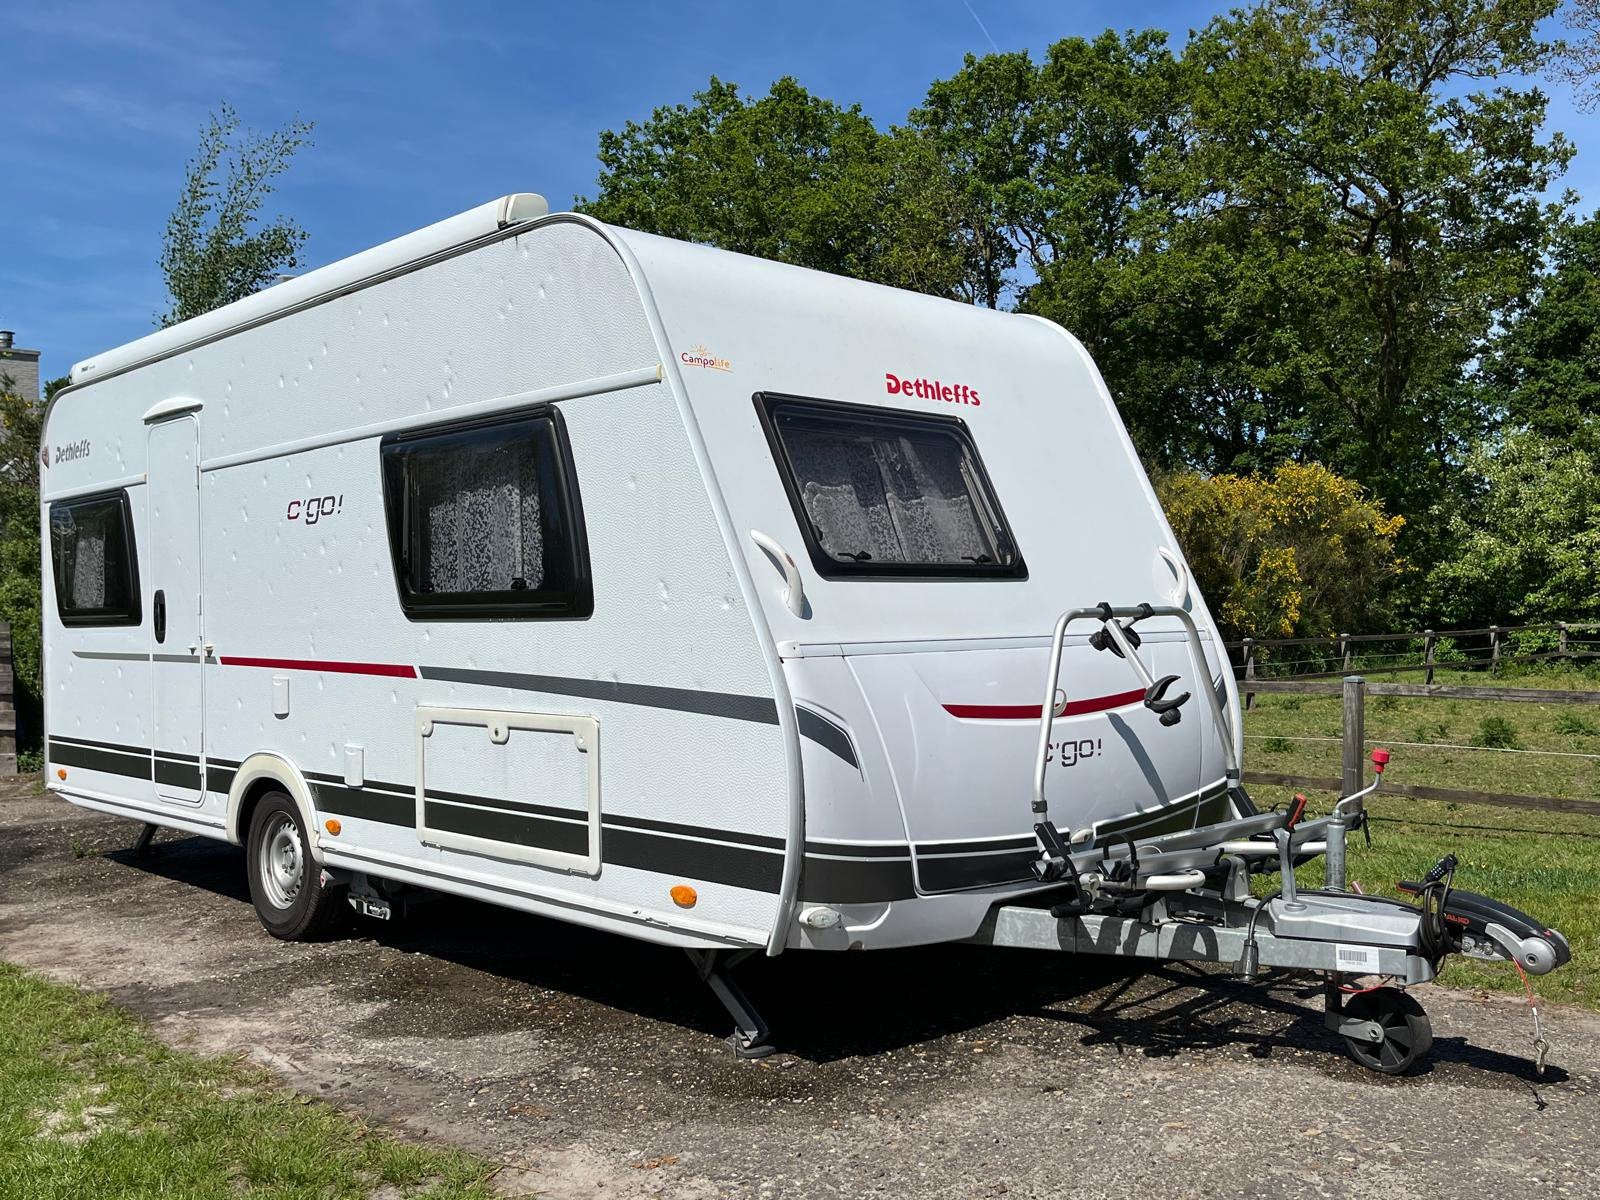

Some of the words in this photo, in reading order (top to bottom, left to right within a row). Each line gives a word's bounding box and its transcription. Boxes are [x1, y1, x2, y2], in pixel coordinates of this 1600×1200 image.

[681, 352, 730, 368] Campolife
[886, 373, 981, 406] Dethleffs
[55, 439, 91, 464] Dethleffs
[287, 494, 343, 525] c'go!
